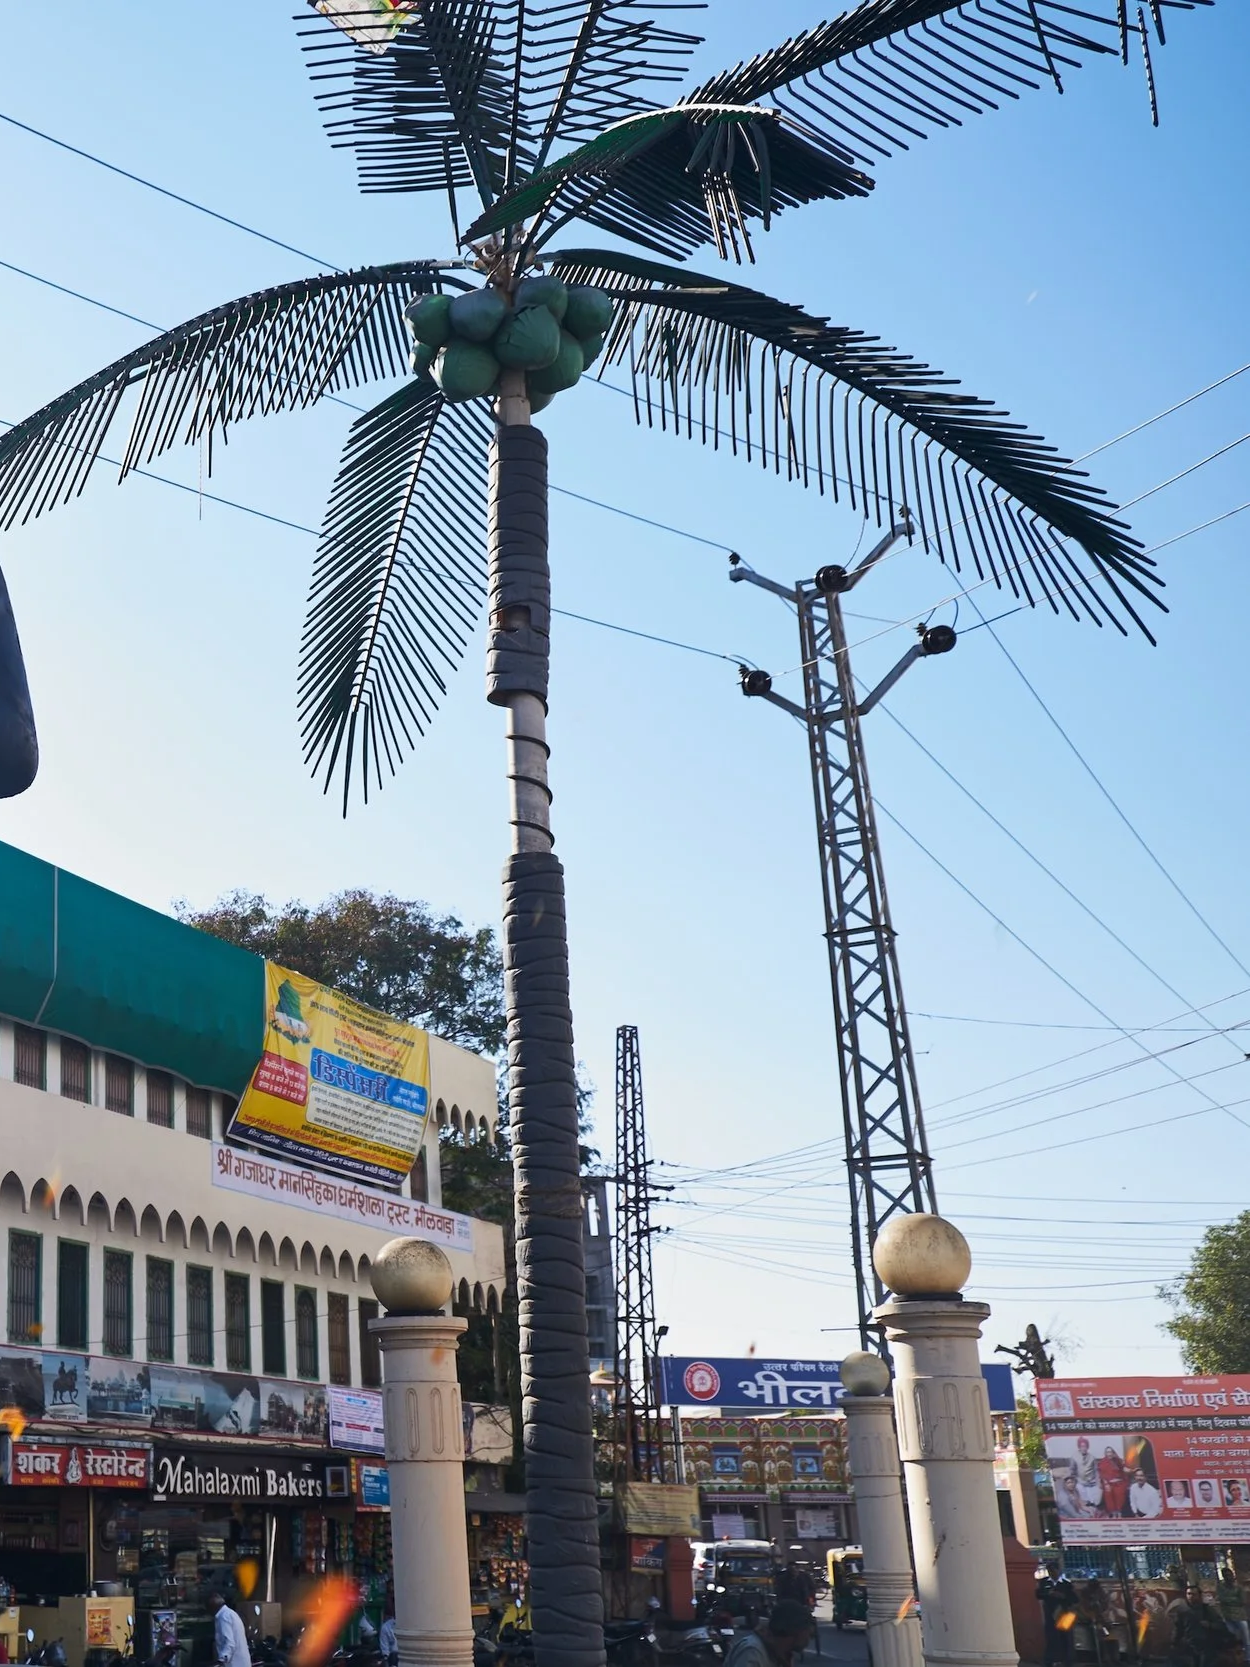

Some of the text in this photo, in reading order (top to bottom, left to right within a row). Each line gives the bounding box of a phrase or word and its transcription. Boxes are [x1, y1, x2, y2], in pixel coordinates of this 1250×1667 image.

[314, 1054, 389, 1104] डिस्पेंसरी
[217, 1147, 232, 1176] श्री
[234, 1157, 277, 1191] गजाधर
[414, 1205, 455, 1239] भीलवाड़ा
[762, 1361, 839, 1373] उत्तर पश्चिम रेलवे
[1076, 1391, 1140, 1410] संस्कार
[1143, 1388, 1199, 1409] निर्माण
[1203, 1391, 1229, 1411] एवं
[1045, 1422, 1056, 1431] 14
[1144, 1420, 1167, 1429] 2018
[84, 1448, 146, 1478] रेस्टोरेन्ट
[156, 1455, 261, 1497] Mahalaxmi
[266, 1469, 322, 1498] Bakers
